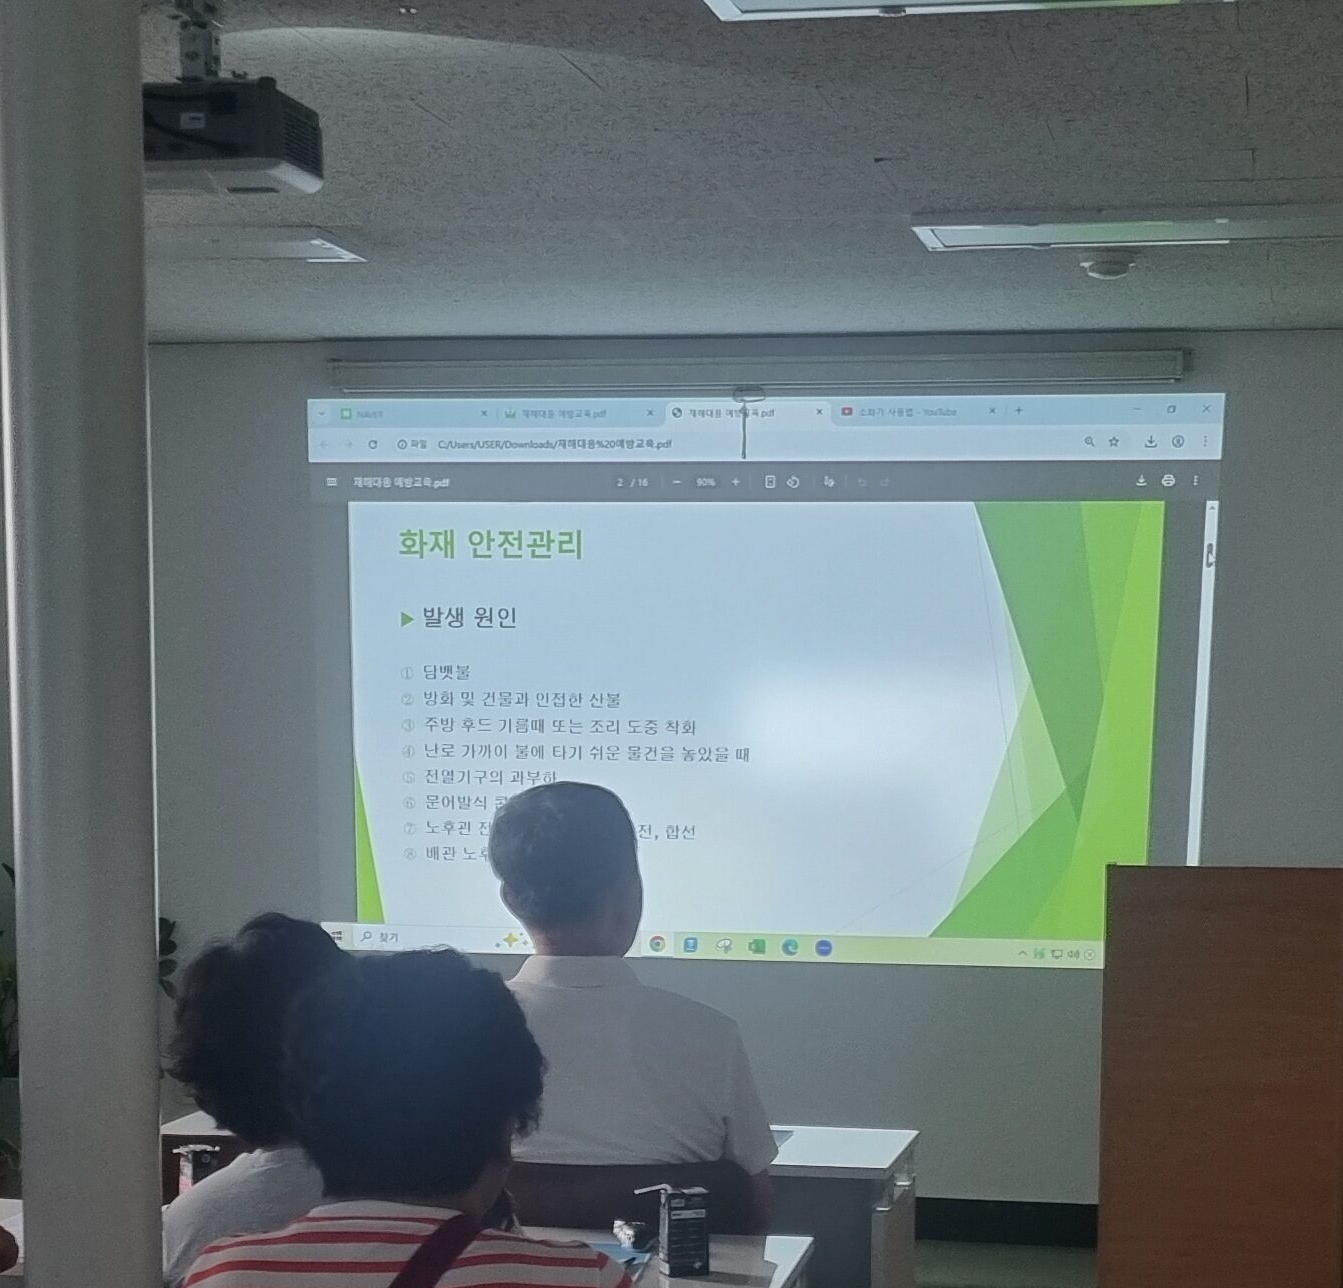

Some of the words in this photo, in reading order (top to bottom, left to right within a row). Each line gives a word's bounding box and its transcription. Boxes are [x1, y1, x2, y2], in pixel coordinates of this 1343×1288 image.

[696, 477, 716, 488] 90%
[399, 528, 456, 561] 화재
[467, 528, 585, 561] 안전관리
[422, 606, 465, 630] 발생
[473, 606, 518, 630] 원인
[423, 663, 471, 681] 담뱃불
[423, 691, 455, 707] 방화
[460, 691, 476, 707] 및
[481, 691, 529, 708] 건물과
[536, 691, 583, 709] 인접한
[589, 692, 621, 709] 산불
[425, 716, 455, 734] 주방
[461, 716, 492, 734] 후드
[499, 717, 546, 734] 기름때
[552, 718, 584, 735] 또는
[589, 718, 621, 736] 조리
[627, 719, 659, 736] 도중
[665, 719, 697, 737] 착화
[424, 743, 456, 759] 난로
[461, 743, 508, 760] 가까이
[514, 743, 545, 760] 불에
[552, 744, 583, 761] 타기
[589, 744, 621, 762] 쉬운
[627, 745, 675, 763] 물건을
[735, 747, 750, 764] 때
[425, 768, 503, 786] 전열기구의
[510, 769, 557, 786] 과부하
[425, 794, 488, 811] 문어발식
[478, 820, 492, 837] 전
[665, 824, 696, 841] 합선
[425, 845, 456, 862] 배관
[379, 931, 399, 944] 찾기
